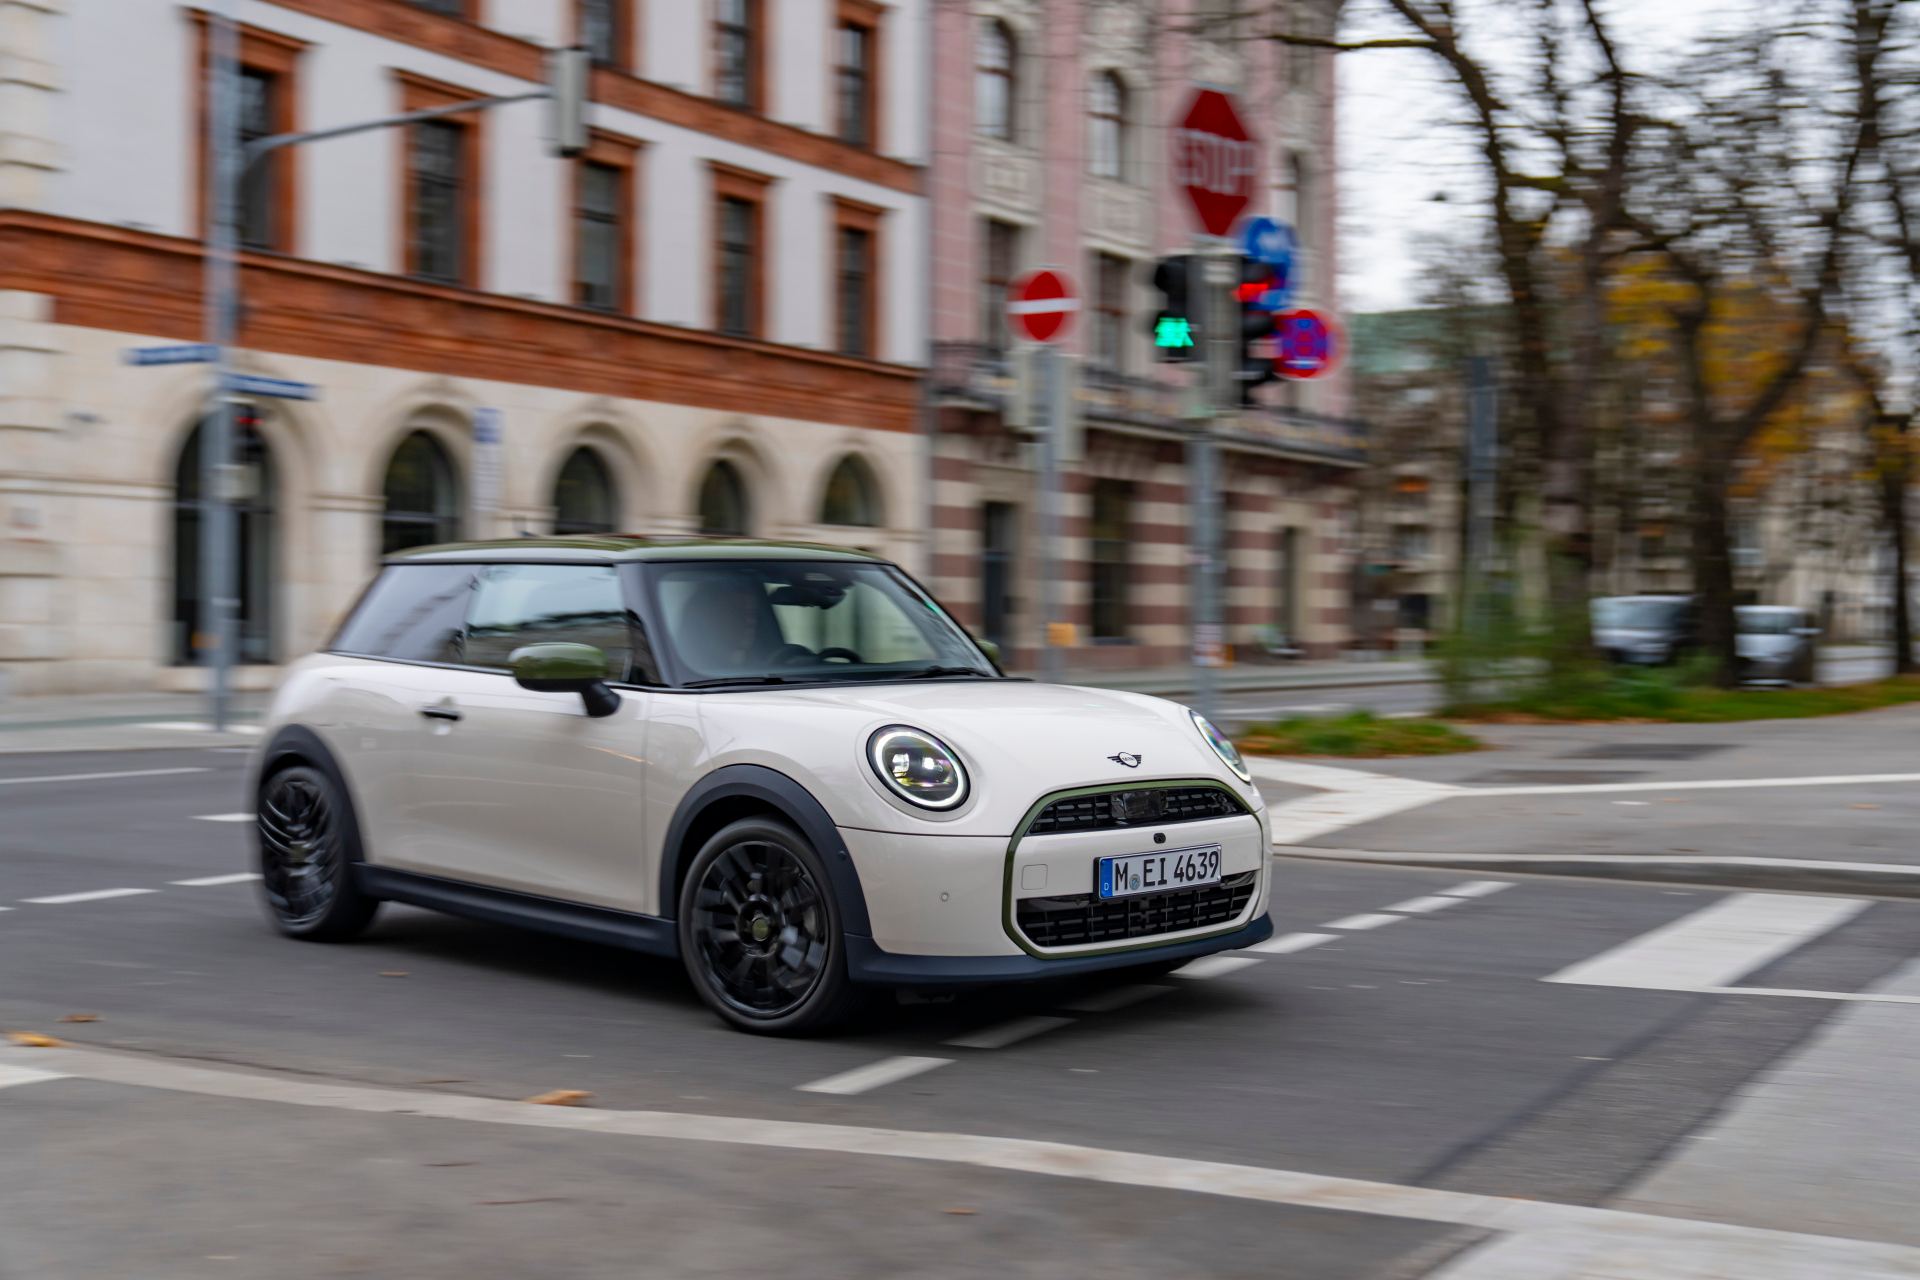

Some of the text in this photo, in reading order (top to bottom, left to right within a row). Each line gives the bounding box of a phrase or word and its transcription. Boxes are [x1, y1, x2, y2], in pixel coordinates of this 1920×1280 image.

[1177, 128, 1256, 194] STOP
[1103, 882, 1110, 891] D
[1115, 850, 1220, 891] M EI 4639
